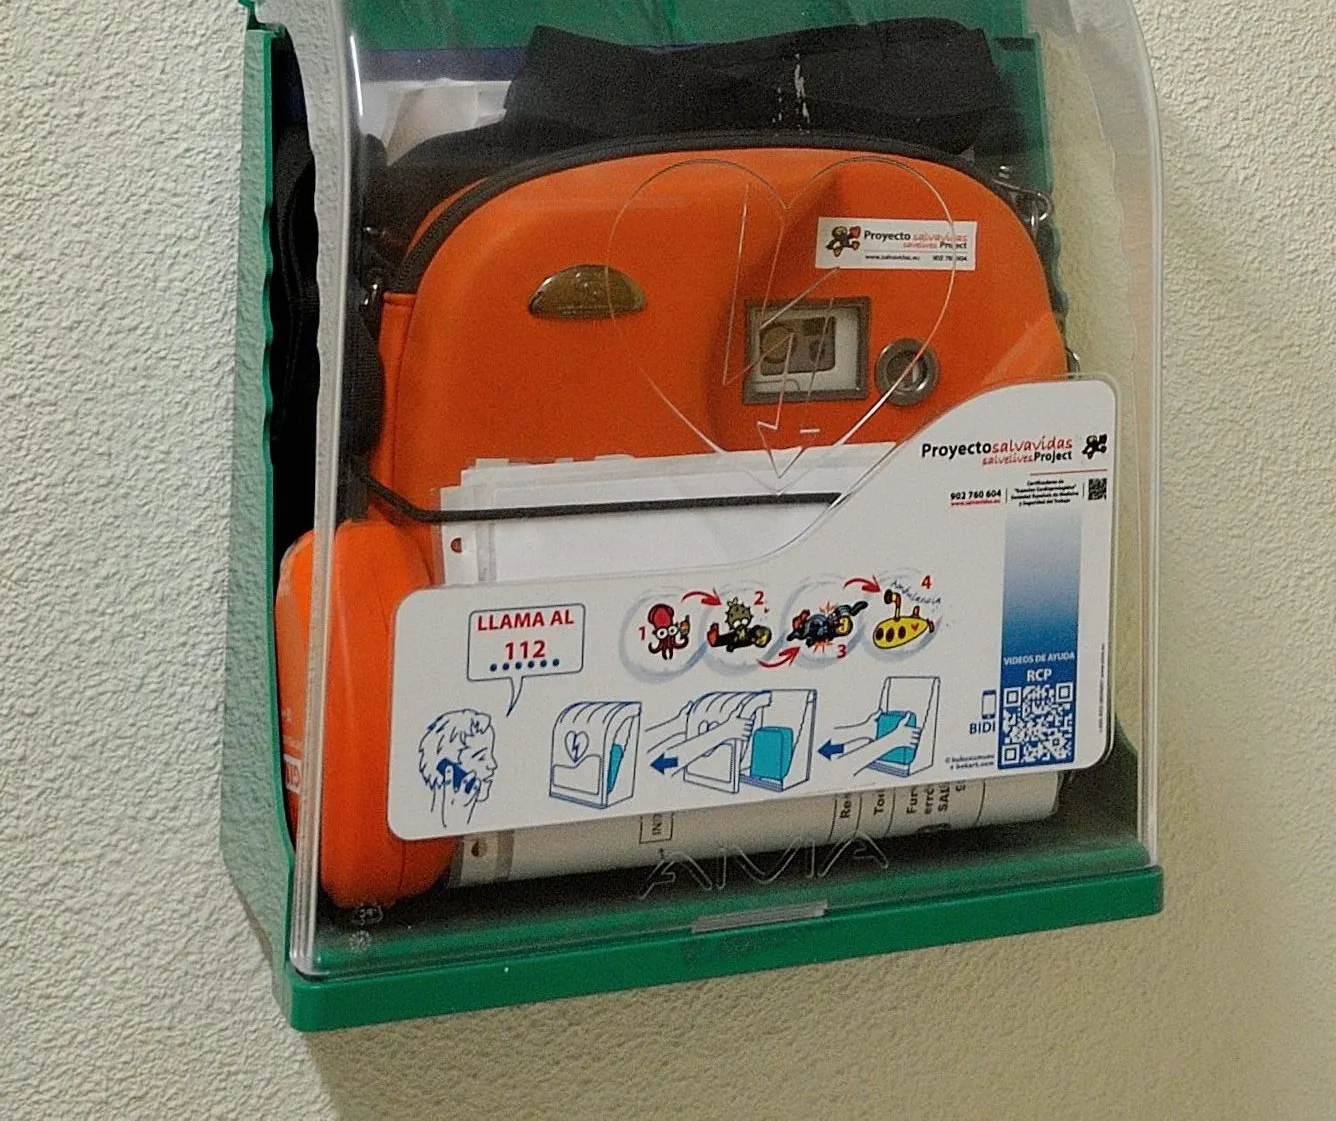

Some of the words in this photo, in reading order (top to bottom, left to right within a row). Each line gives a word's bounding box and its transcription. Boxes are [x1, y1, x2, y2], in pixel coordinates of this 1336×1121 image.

[864, 230, 911, 242] Proyecto
[939, 241, 968, 249] Proect
[921, 575, 932, 590] 4
[754, 591, 765, 606] 2
[477, 611, 544, 631] LLAMA
[550, 609, 574, 626] AL
[639, 626, 646, 641] 1
[505, 639, 545, 660] 112
[836, 644, 847, 659] 3
[1003, 656, 1034, 665] VIDEOS
[1035, 654, 1047, 663] DE
[1049, 652, 1075, 661] AYUDA
[1026, 668, 1052, 682] RCP
[969, 720, 996, 734] BIDI
